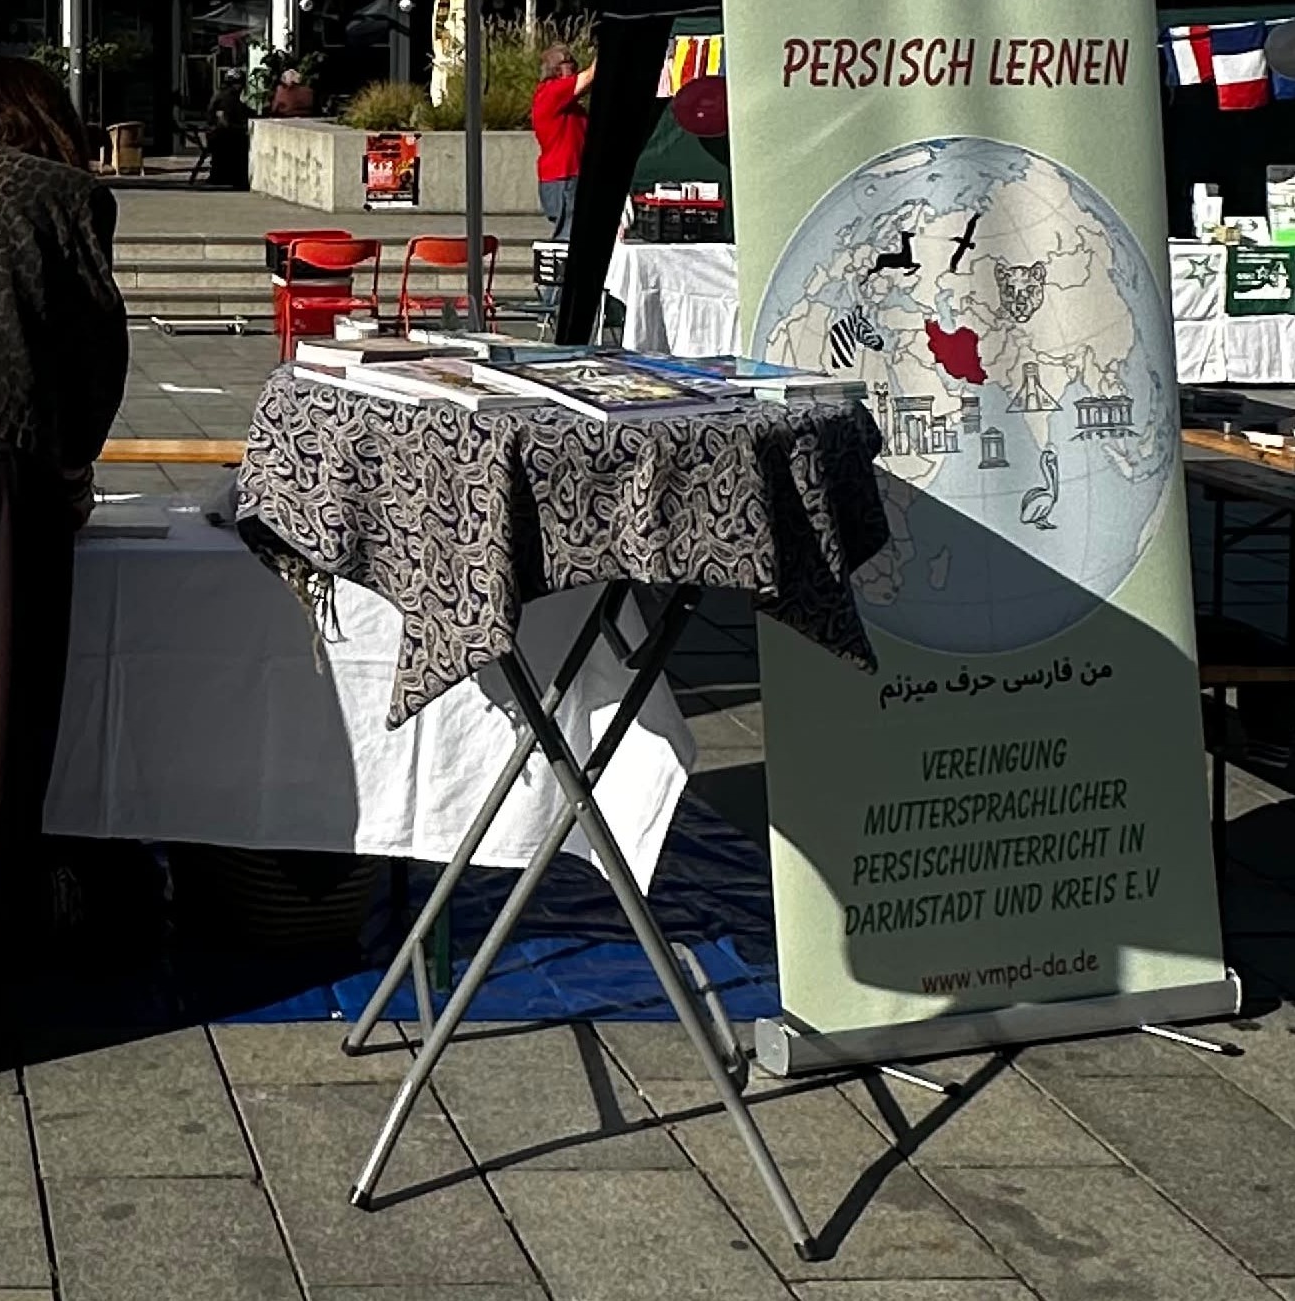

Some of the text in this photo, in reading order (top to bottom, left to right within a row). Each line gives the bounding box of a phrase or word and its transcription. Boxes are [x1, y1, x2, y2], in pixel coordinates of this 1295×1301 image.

[783, 37, 1130, 89] PERSISCH LERNEN
[879, 657, 1113, 710] من فارسی حرف میزنم
[921, 737, 1068, 782] VEREINGUNG
[863, 778, 1128, 837] MUTTERSPRACHLICHER
[852, 823, 1145, 887] PERSISCHUNTERRICHT IN
[844, 867, 1162, 937] DARMSTADT UND KREIS E.V
[921, 949, 1099, 995] www.vmpd-da.de
